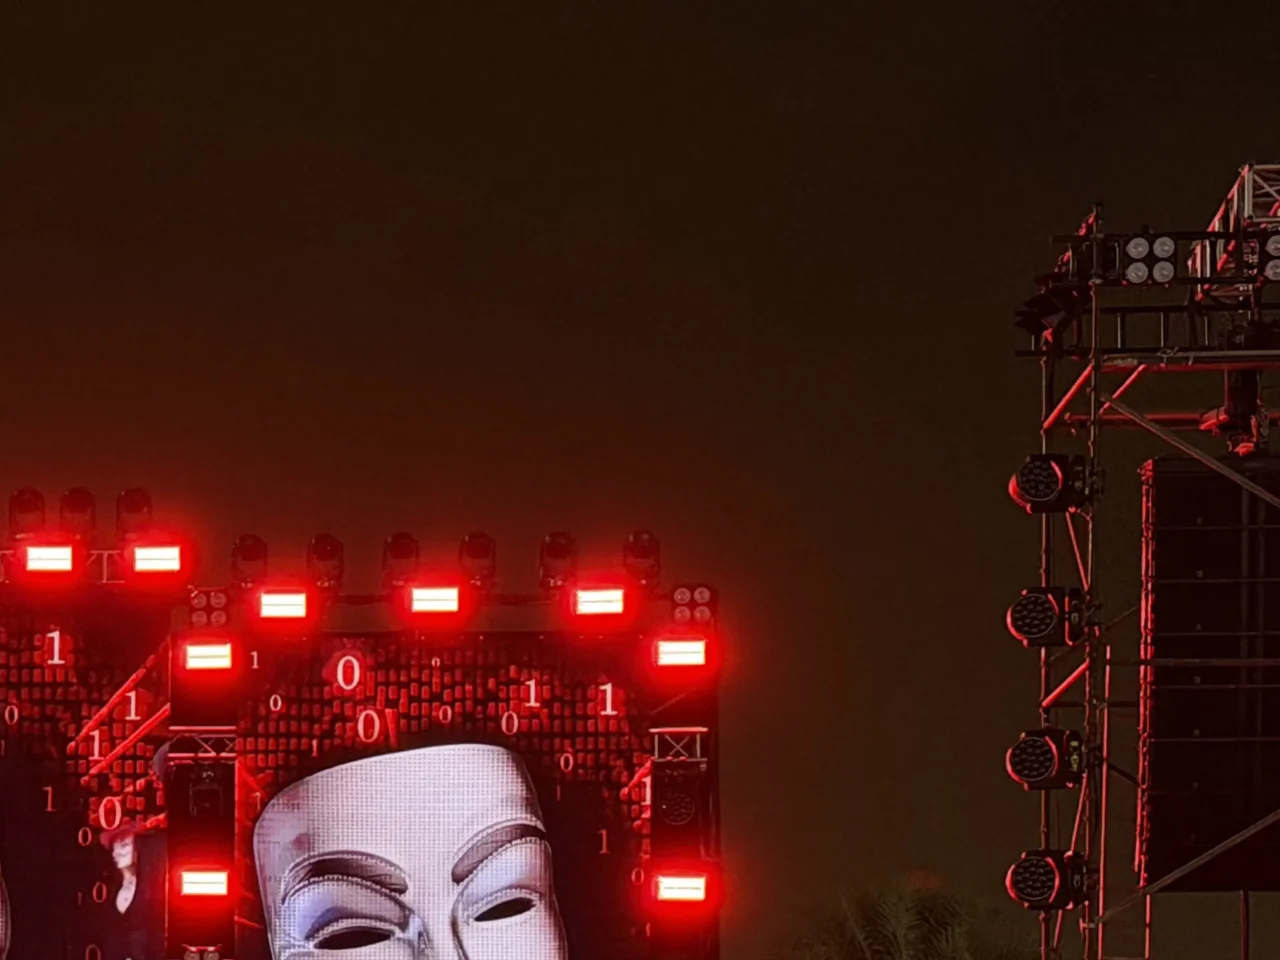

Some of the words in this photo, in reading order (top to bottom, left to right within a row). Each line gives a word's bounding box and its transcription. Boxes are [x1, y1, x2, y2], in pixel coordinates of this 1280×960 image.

[46, 631, 65, 664] 1
[251, 651, 259, 669] 1
[337, 656, 360, 690] 0
[125, 691, 141, 720] 1
[270, 694, 282, 711] 0
[524, 679, 541, 707] 1
[599, 683, 618, 715] 1
[5, 705, 18, 725] 0
[358, 709, 380, 743] 0
[439, 705, 452, 723] 0
[501, 711, 518, 735] 0
[88, 729, 104, 760] 1
[312, 739, 319, 757] 1
[560, 753, 574, 772] 0
[42, 786, 57, 812] 1
[641, 777, 651, 805] 1
[99, 796, 121, 830] 0
[78, 827, 92, 846] 0
[599, 829, 610, 854] 1
[632, 867, 644, 886] 0
[93, 882, 107, 903] 0
